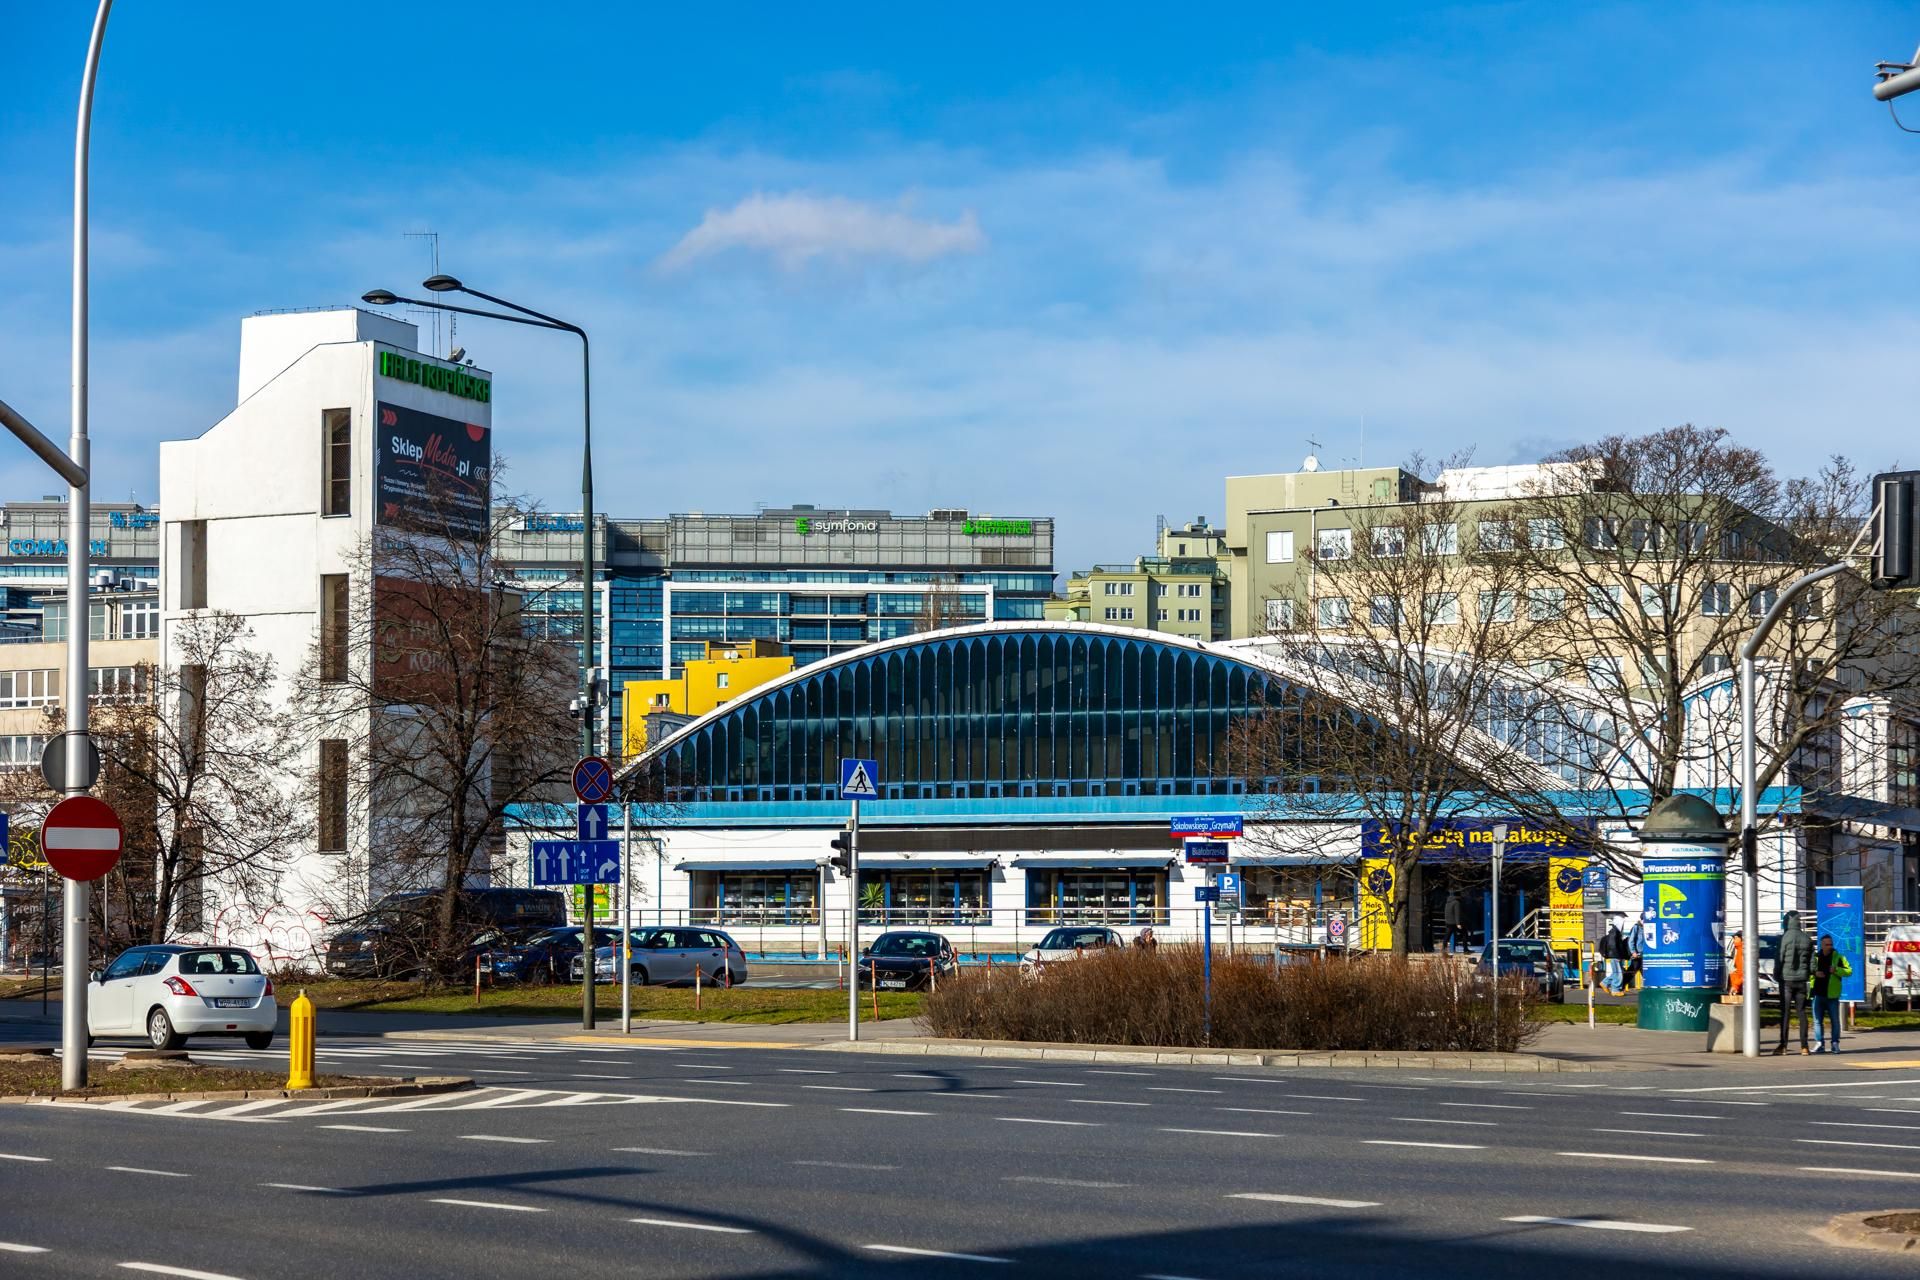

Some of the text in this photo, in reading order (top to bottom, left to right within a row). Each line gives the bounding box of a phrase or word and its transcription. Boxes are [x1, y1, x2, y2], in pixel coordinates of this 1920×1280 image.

[380, 352, 491, 403] HALA KOPIŃSKA
[815, 519, 876, 533] symfonia
[9, 539, 107, 555] COMAH
[1469, 830, 1493, 844] na
[1648, 864, 1697, 873] Warszawie
[1701, 864, 1715, 872] PIT
[1223, 876, 1233, 890] P
